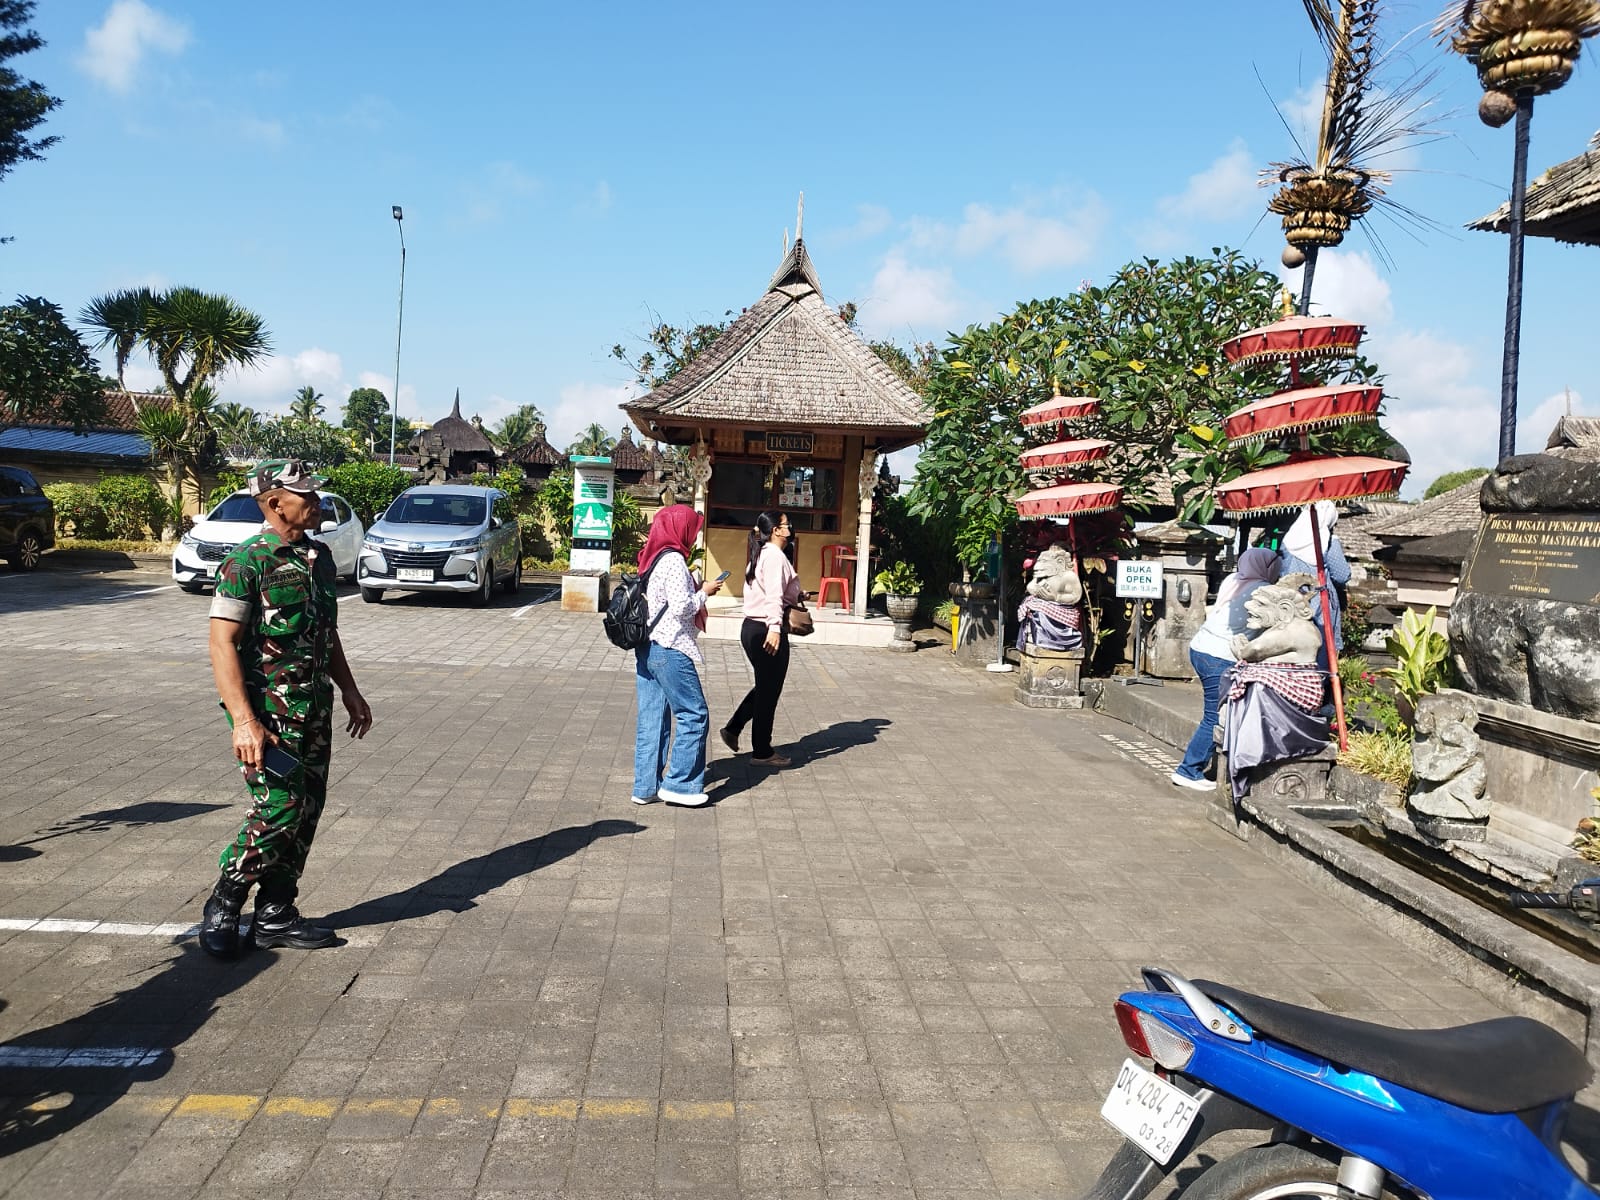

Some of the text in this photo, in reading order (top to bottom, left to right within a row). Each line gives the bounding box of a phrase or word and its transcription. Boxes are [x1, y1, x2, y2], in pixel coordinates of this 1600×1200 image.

[769, 435, 811, 449] TICKETS
[1491, 519, 1512, 530] DESA
[1515, 520, 1545, 531] WISATA
[1495, 532, 1539, 544] BERBASIS
[1126, 565, 1152, 573] BUKA
[1126, 575, 1152, 583] OPEN
[1117, 1066, 1193, 1129] DK 4284 PF
